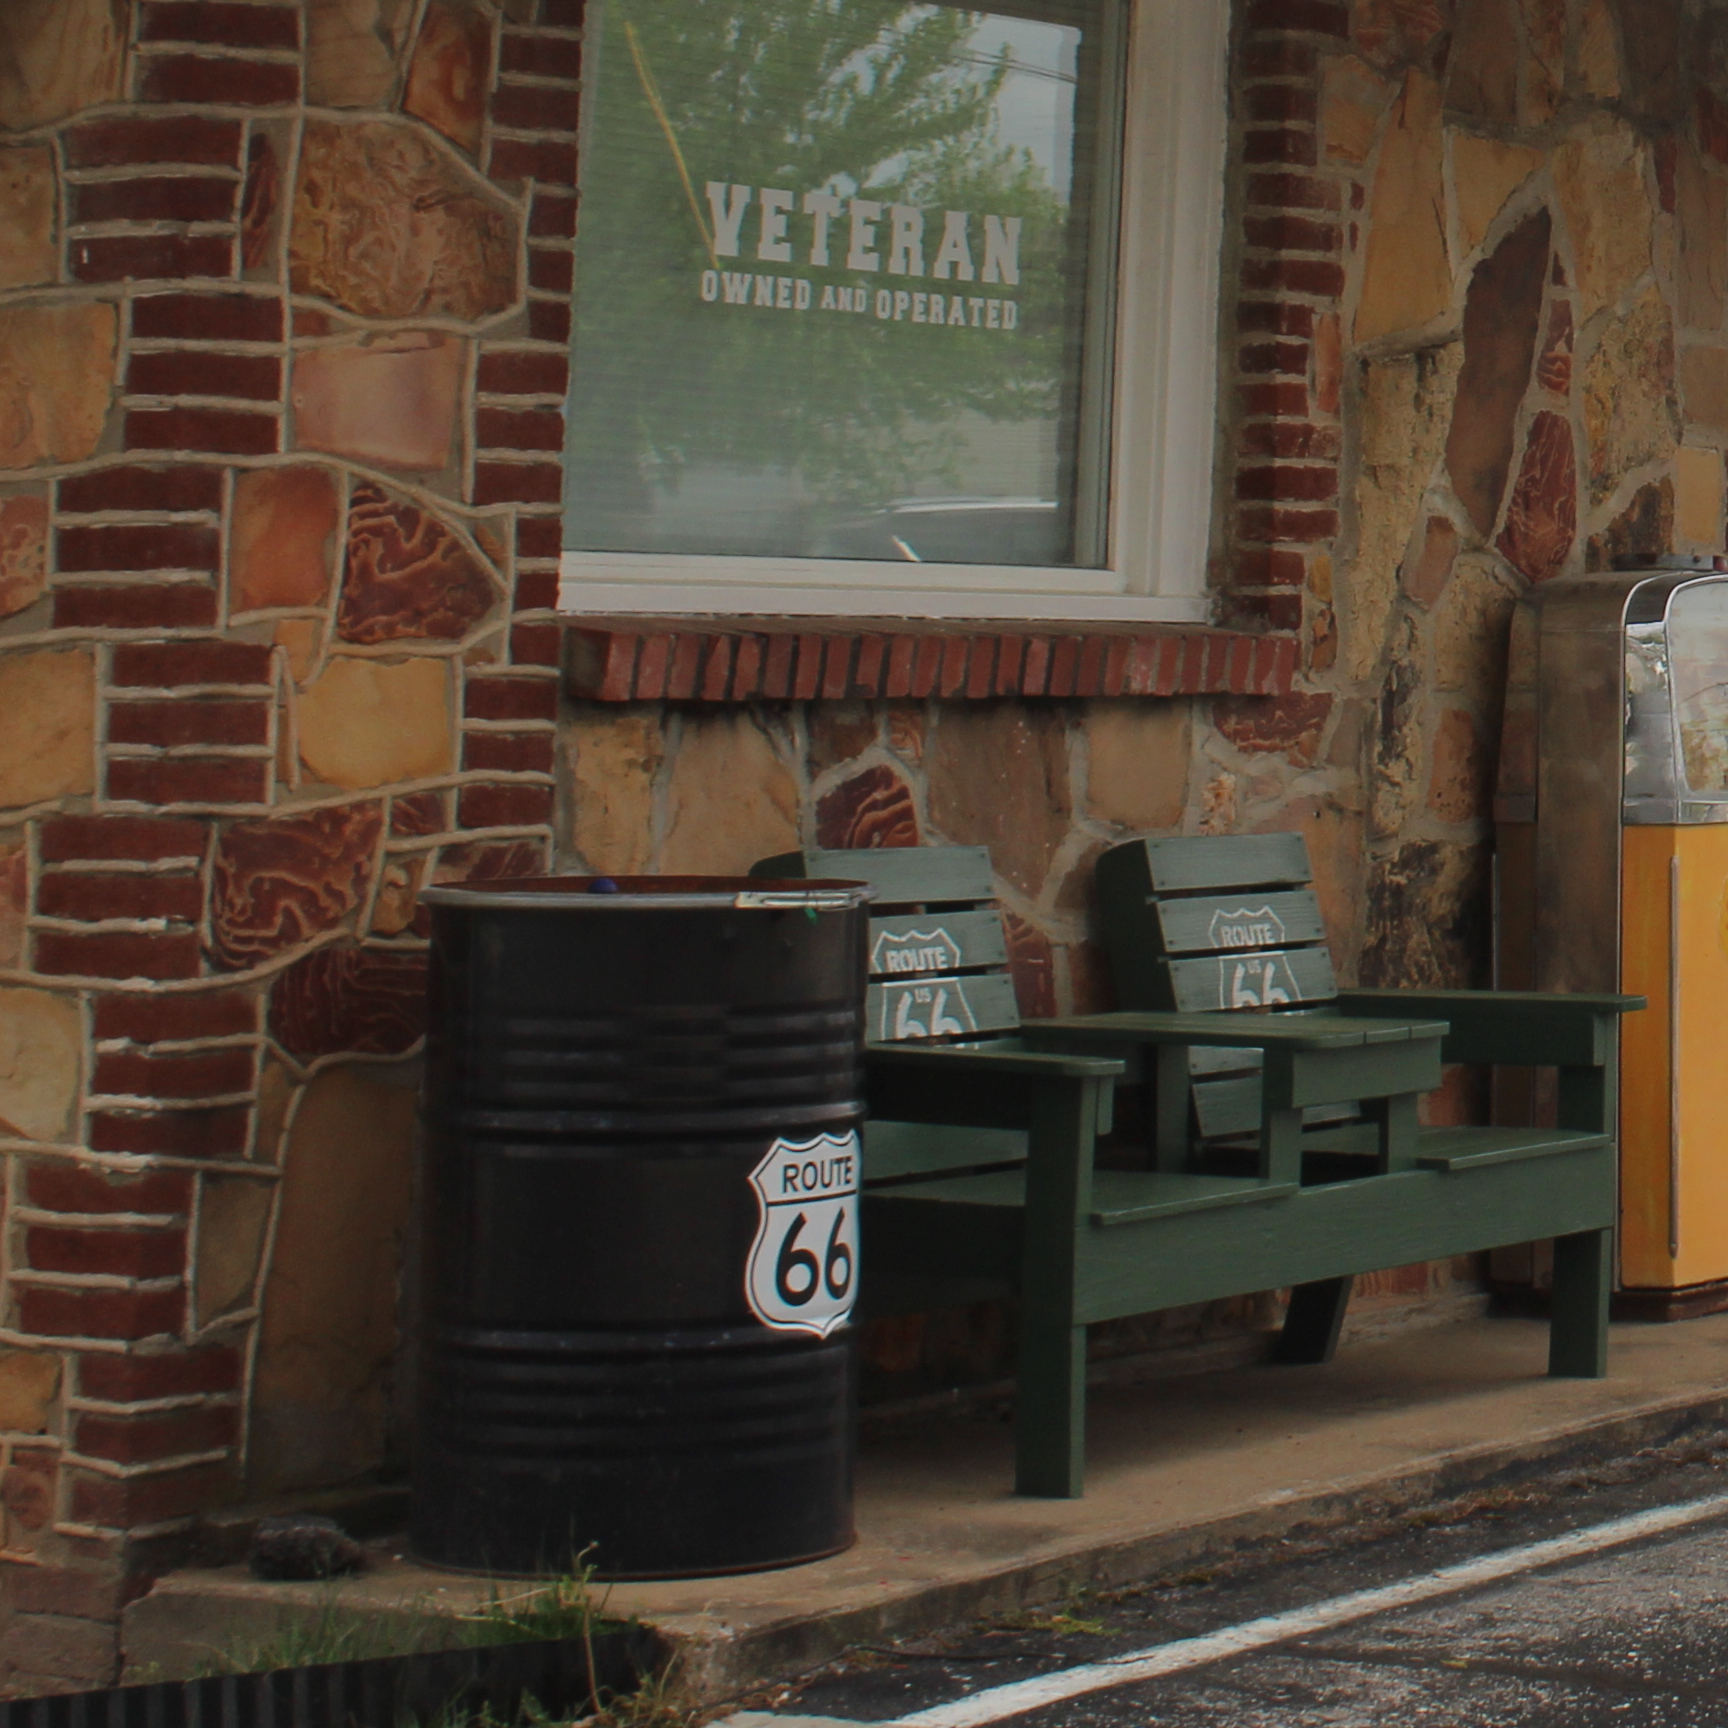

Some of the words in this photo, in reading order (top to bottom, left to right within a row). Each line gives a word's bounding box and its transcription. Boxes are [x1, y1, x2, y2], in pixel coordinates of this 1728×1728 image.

[704, 180, 1022, 286] VETERAN
[701, 269, 811, 311] OWNED
[820, 284, 867, 315] AND
[876, 288, 1018, 331] OPERATED
[885, 946, 949, 972] ROUTE
[1221, 923, 1276, 947] ROUTE
[781, 1155, 853, 1194] ROUTE
[774, 1206, 851, 1308] 66
